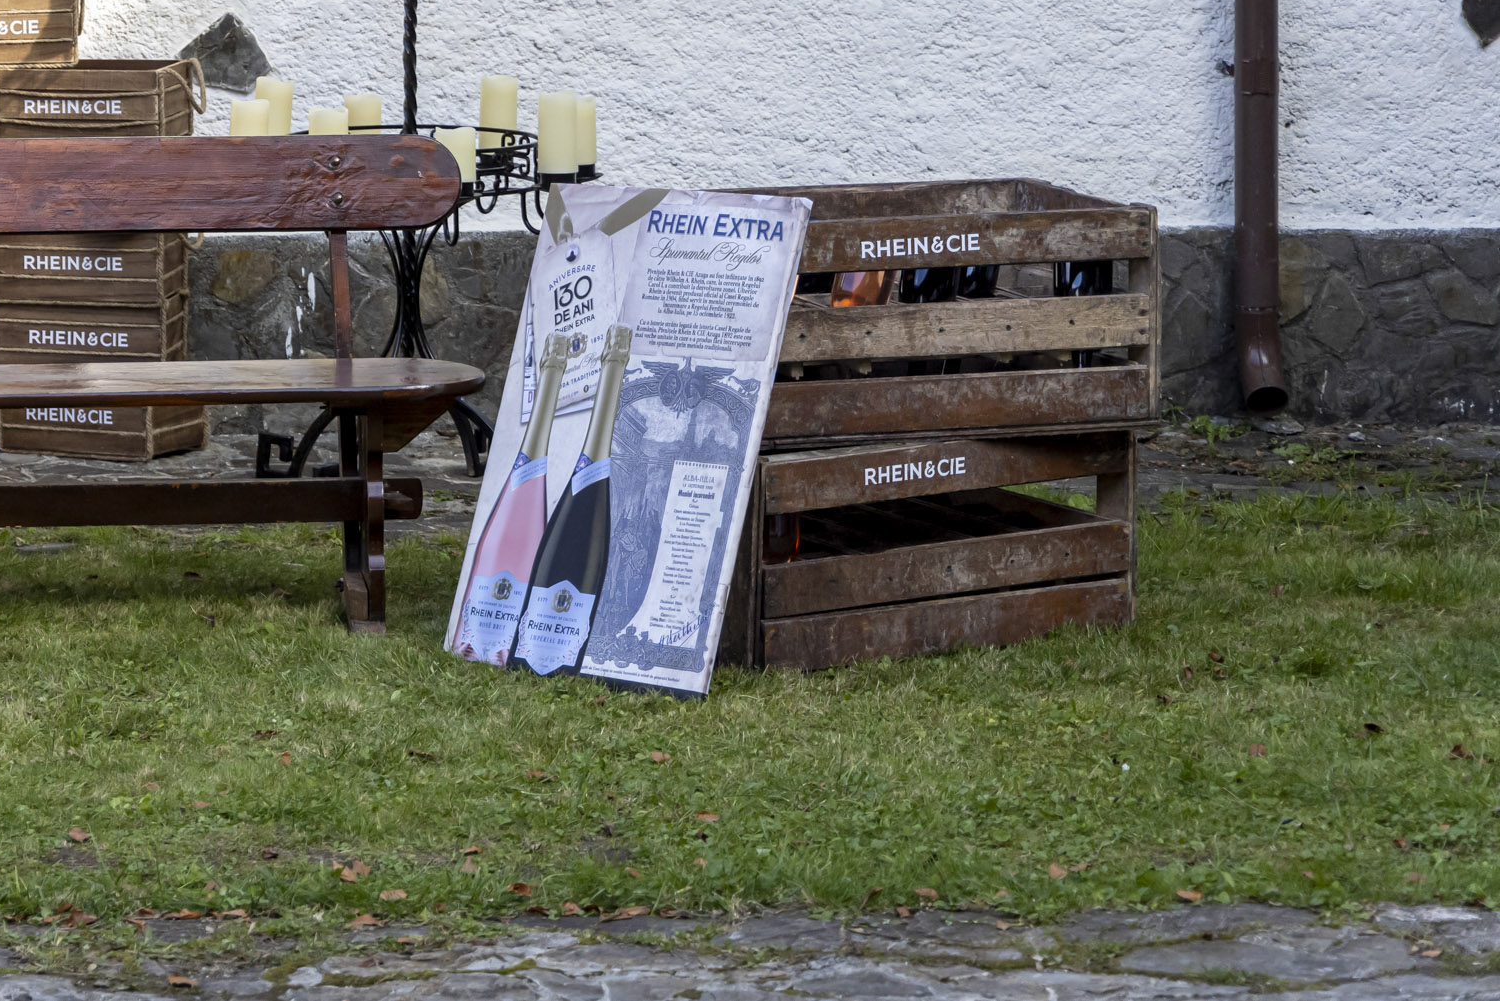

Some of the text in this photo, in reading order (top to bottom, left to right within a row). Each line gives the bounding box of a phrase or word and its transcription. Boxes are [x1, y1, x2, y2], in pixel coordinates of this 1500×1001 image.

[23, 99, 122, 115] RHEIN&CIE
[647, 210, 784, 242] RHEIN EXTRA
[650, 237, 771, 271] Spumantul Regilor
[861, 233, 980, 259] RHEIN&CIE
[23, 255, 123, 272] RHEIN&CIE
[548, 264, 597, 291] ANIVERSARE
[553, 275, 593, 311] 130
[554, 298, 594, 326] DE ANI
[575, 314, 595, 328] EXTRA
[28, 330, 128, 348] RHEIN&CIE
[25, 407, 113, 424] RHEIN&CIE
[864, 456, 966, 486] RHEIN&CIE
[470, 607, 520, 622] RHEIN EXTRA
[527, 620, 580, 636] RHEIN EXTRA
